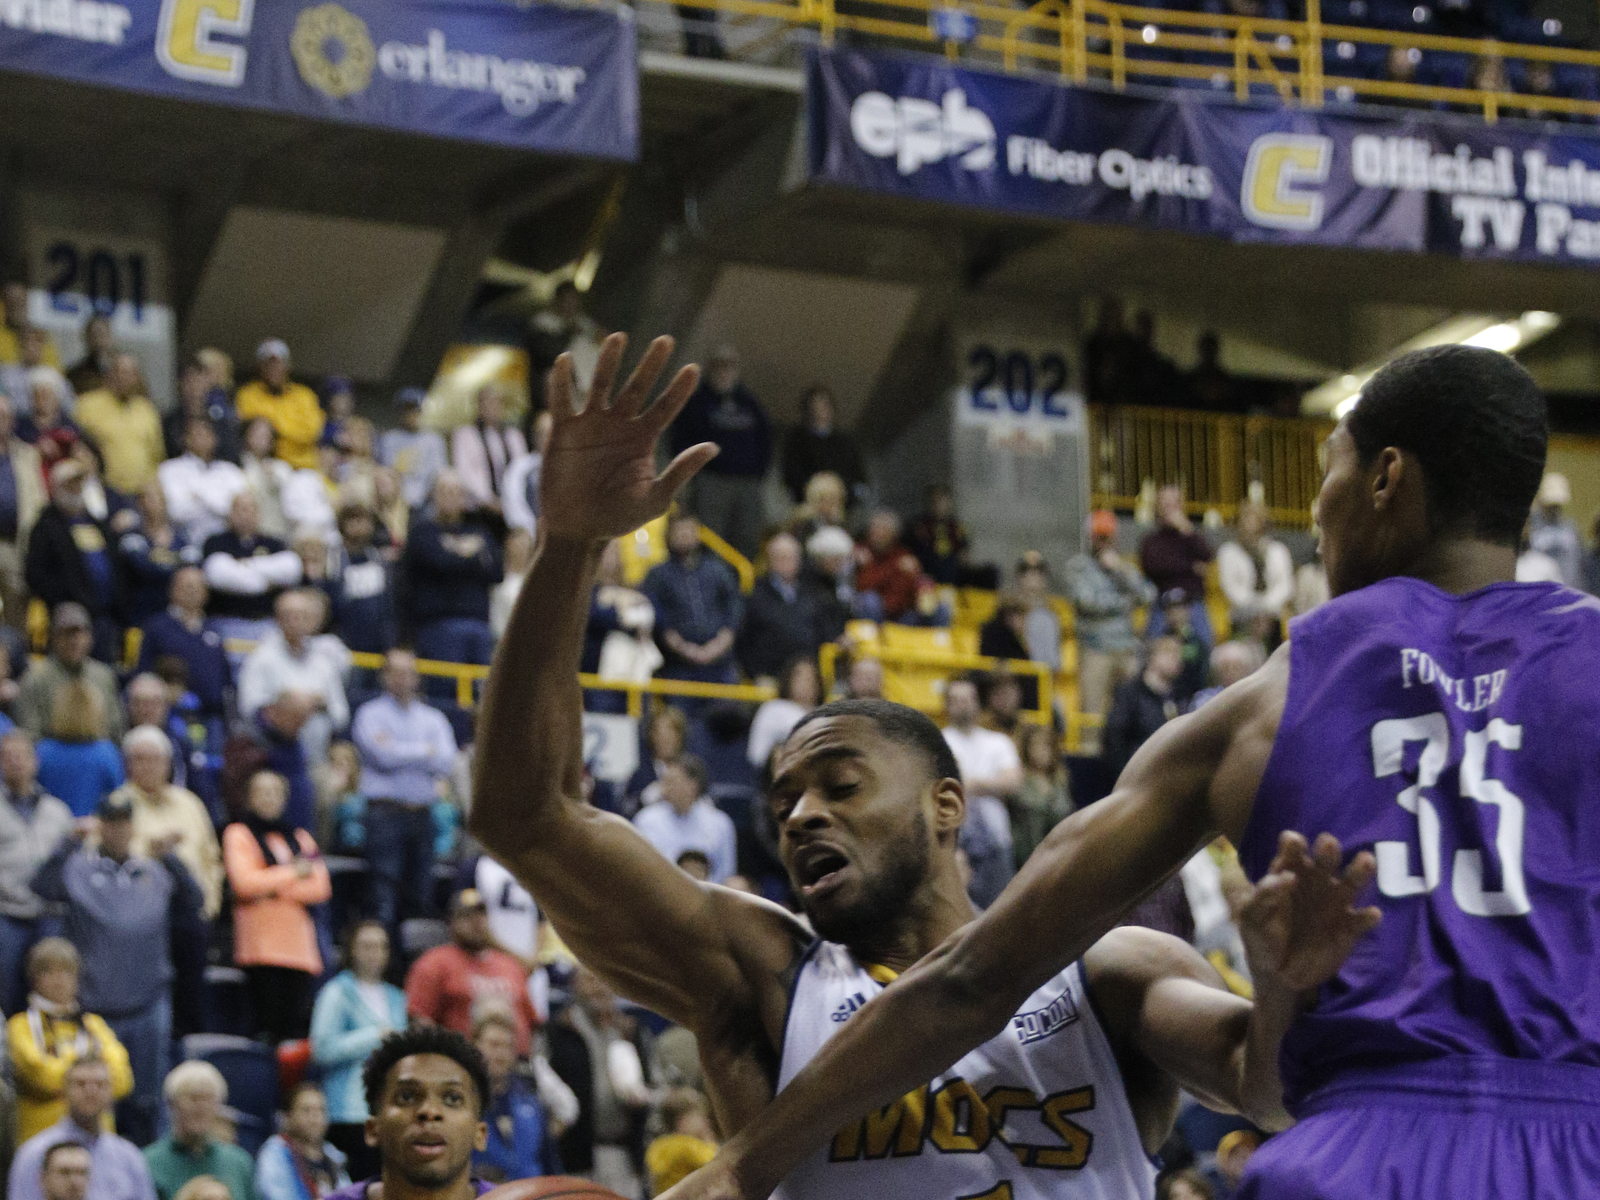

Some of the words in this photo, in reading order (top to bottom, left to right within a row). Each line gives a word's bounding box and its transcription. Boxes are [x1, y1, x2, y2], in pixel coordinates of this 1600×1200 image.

[378, 28, 586, 116] erlanger
[850, 88, 997, 175] epb
[1005, 135, 1098, 185] Fiber
[1099, 149, 1213, 200] Optics
[1351, 134, 1516, 198] Official
[1451, 197, 1526, 250] TV
[47, 240, 144, 323] 201
[969, 345, 1067, 419] 202
[1401, 648, 1508, 712] FOWLER
[1371, 711, 1531, 917] 35
[828, 1076, 1096, 1170] MOCS
